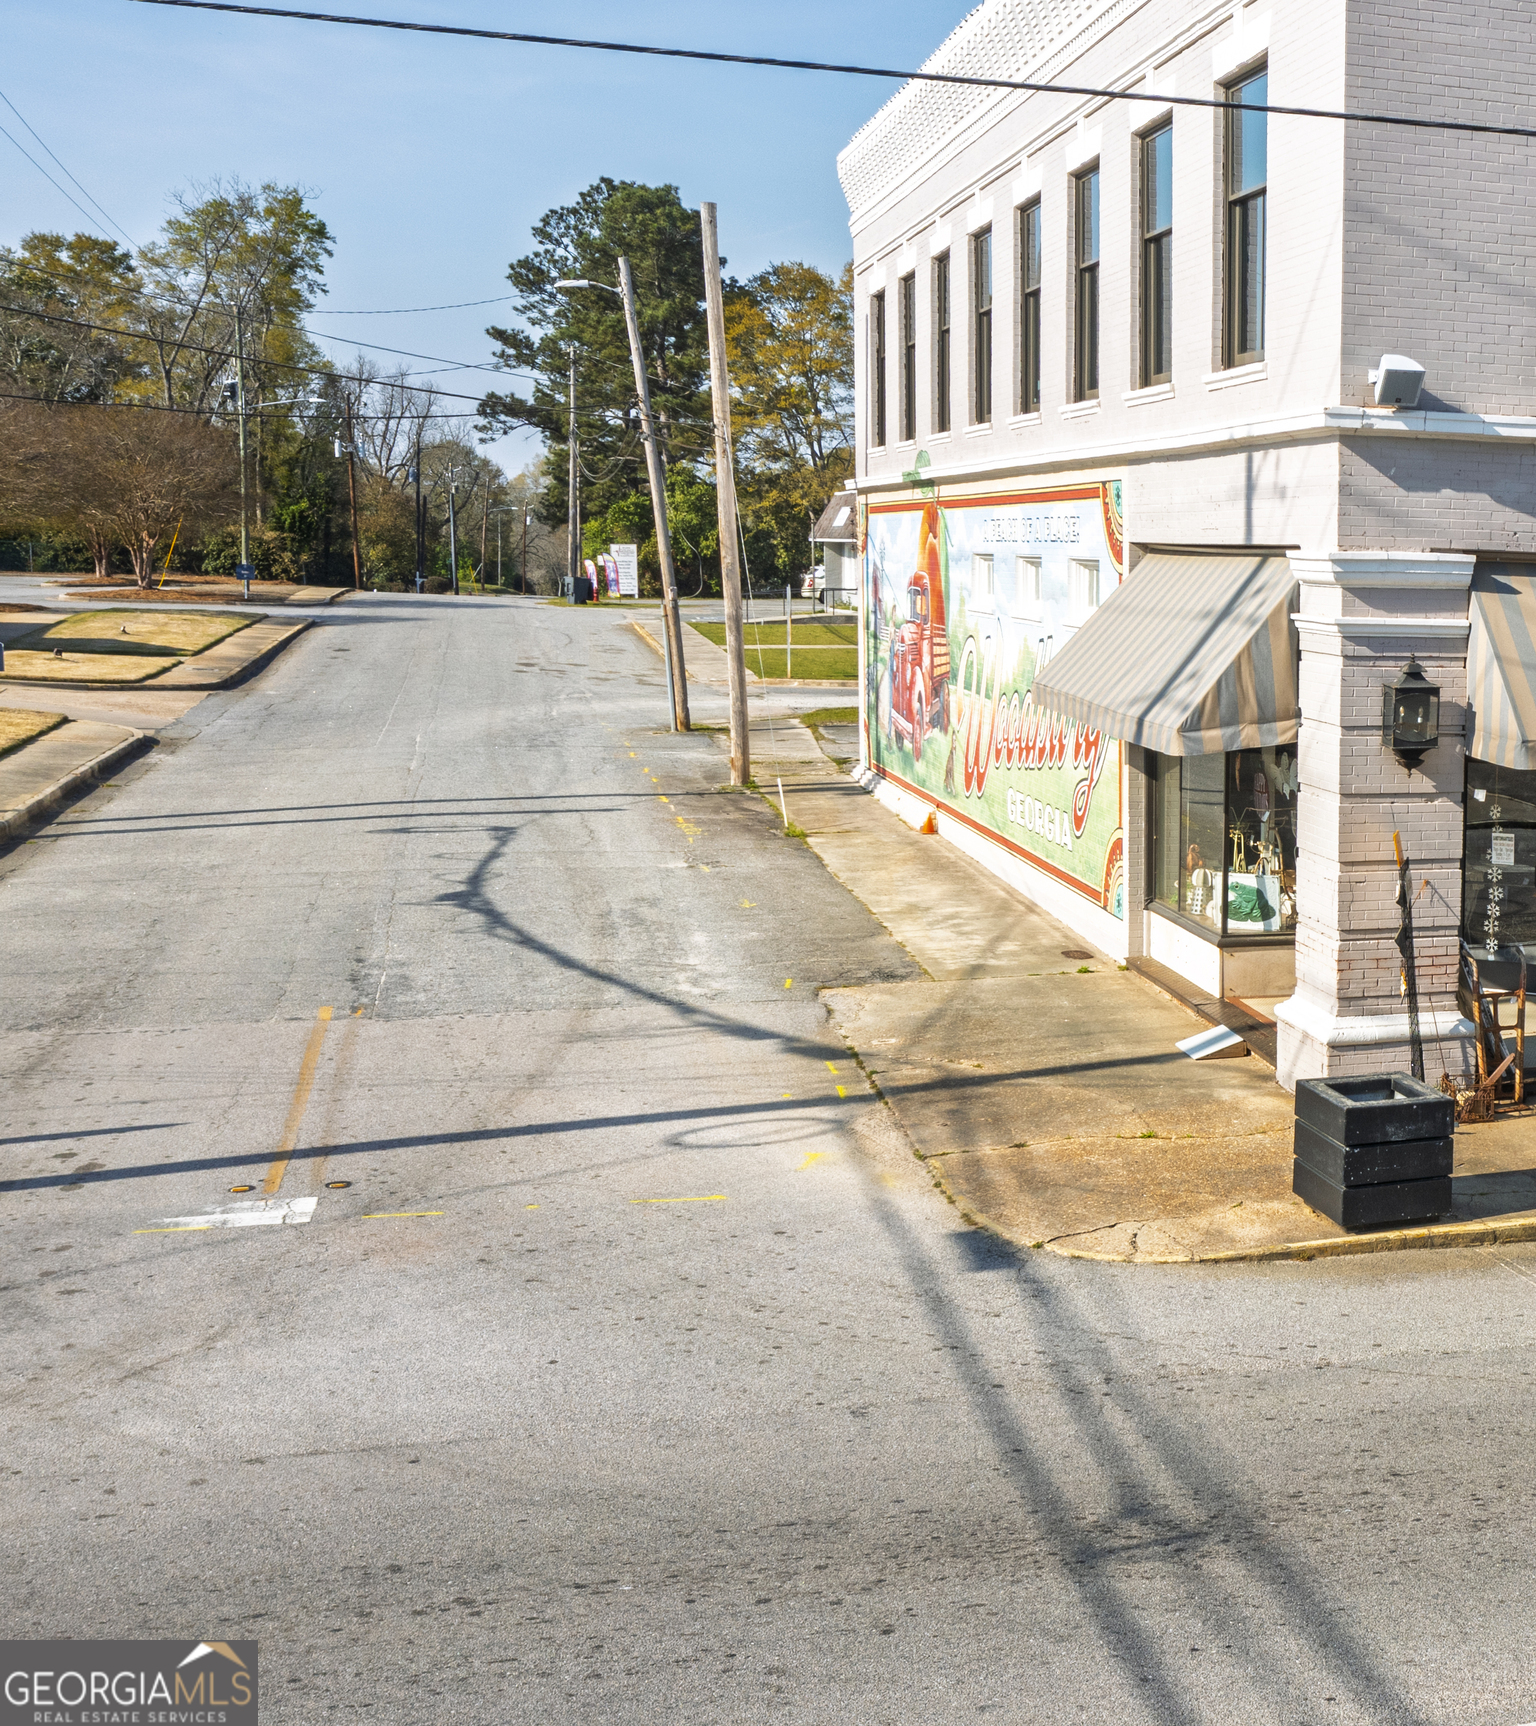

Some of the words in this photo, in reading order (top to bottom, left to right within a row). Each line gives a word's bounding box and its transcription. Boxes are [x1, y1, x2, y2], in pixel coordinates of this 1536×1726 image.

[990, 518, 1018, 542] PEACH
[1021, 517, 1033, 542] OF
[1043, 515, 1080, 543] PLACE!
[1007, 786, 1073, 852] GEORGIA
